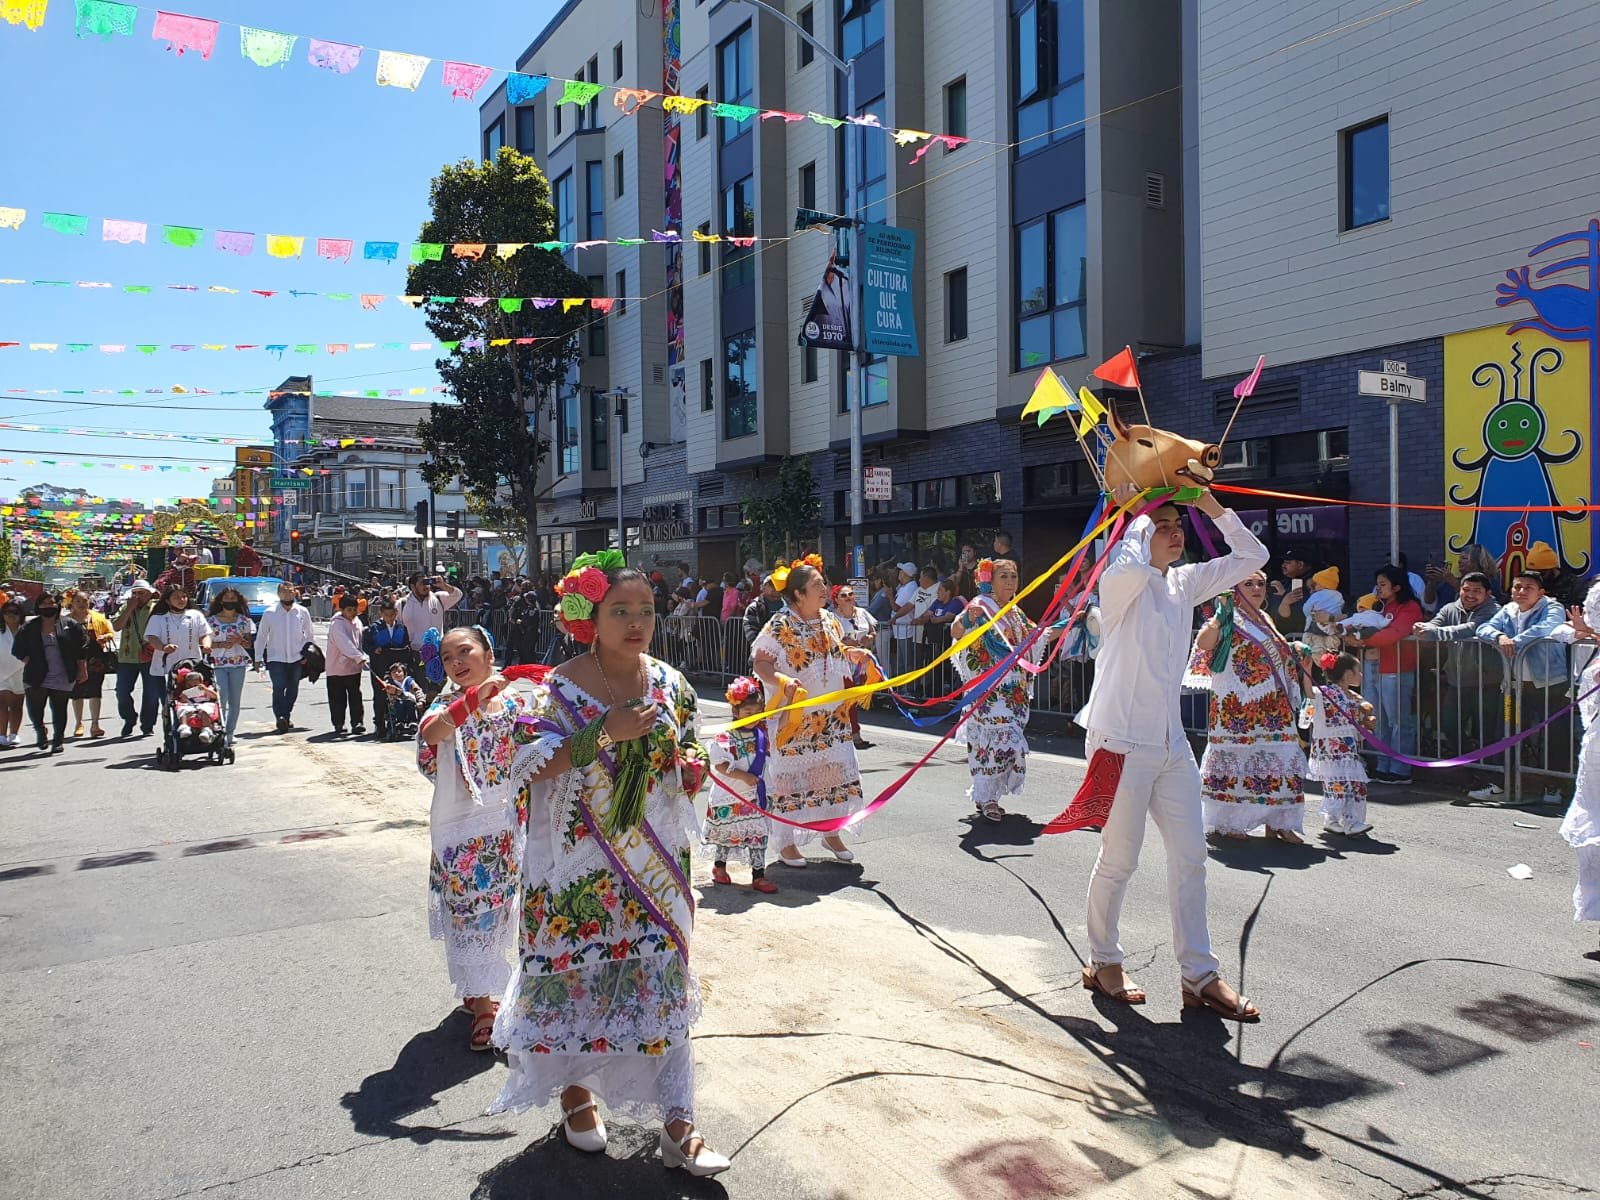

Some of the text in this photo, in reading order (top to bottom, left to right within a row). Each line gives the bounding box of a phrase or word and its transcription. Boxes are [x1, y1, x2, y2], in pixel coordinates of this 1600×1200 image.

[867, 268, 908, 292] CULTURA
[879, 291, 897, 310] QUE
[876, 310, 903, 330] CURA
[823, 331, 843, 341] 1970
[1381, 378, 1412, 399] Balmy
